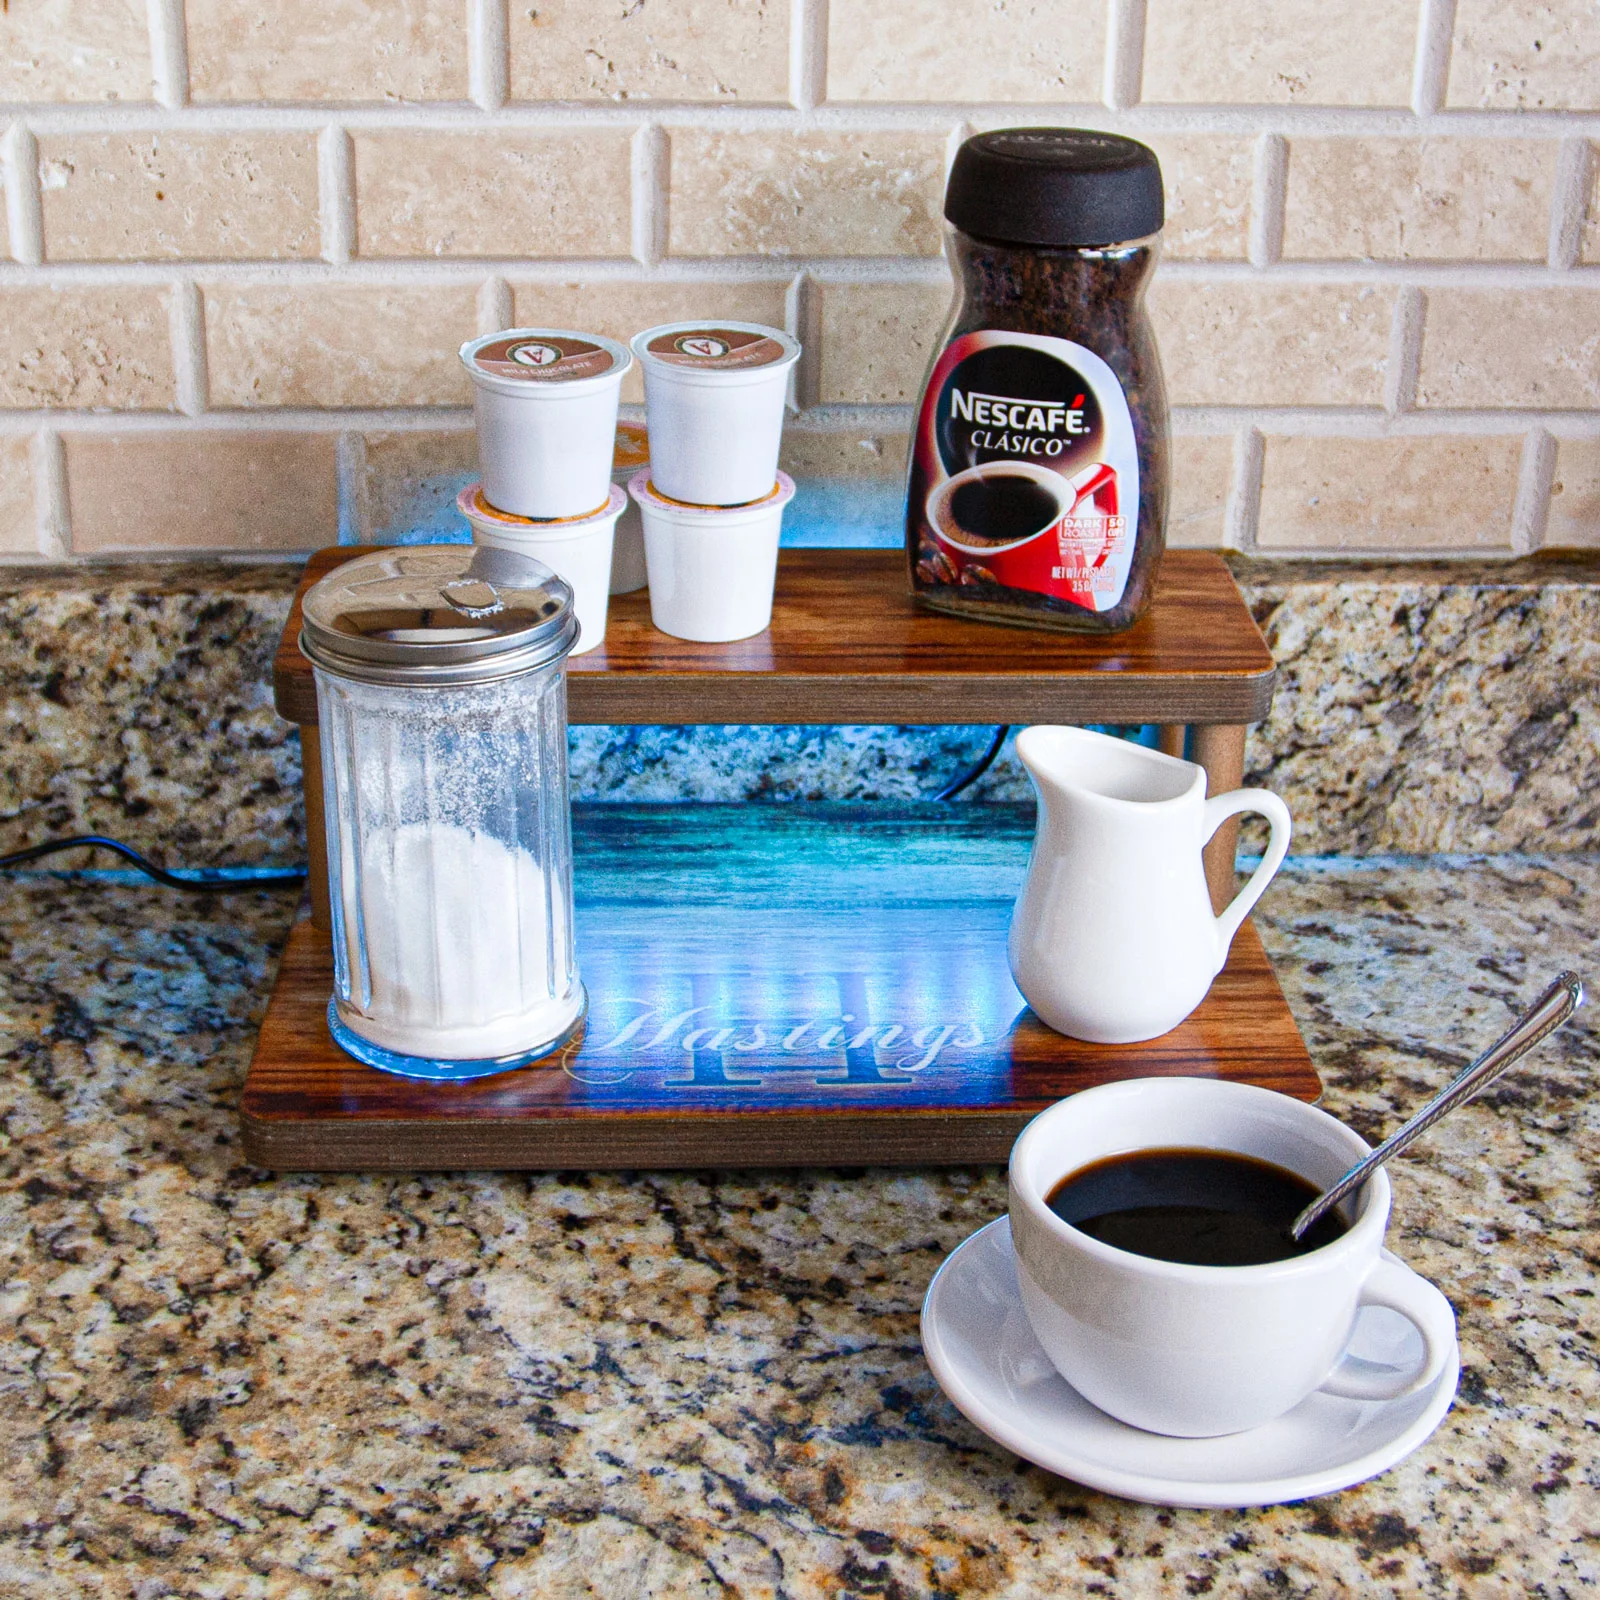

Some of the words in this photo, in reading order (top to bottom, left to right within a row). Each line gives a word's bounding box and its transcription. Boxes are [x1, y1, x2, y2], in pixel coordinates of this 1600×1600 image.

[1064, 518, 1101, 528] DARK
[1064, 528, 1100, 537] ROAST
[562, 997, 1006, 1086] Hastings
